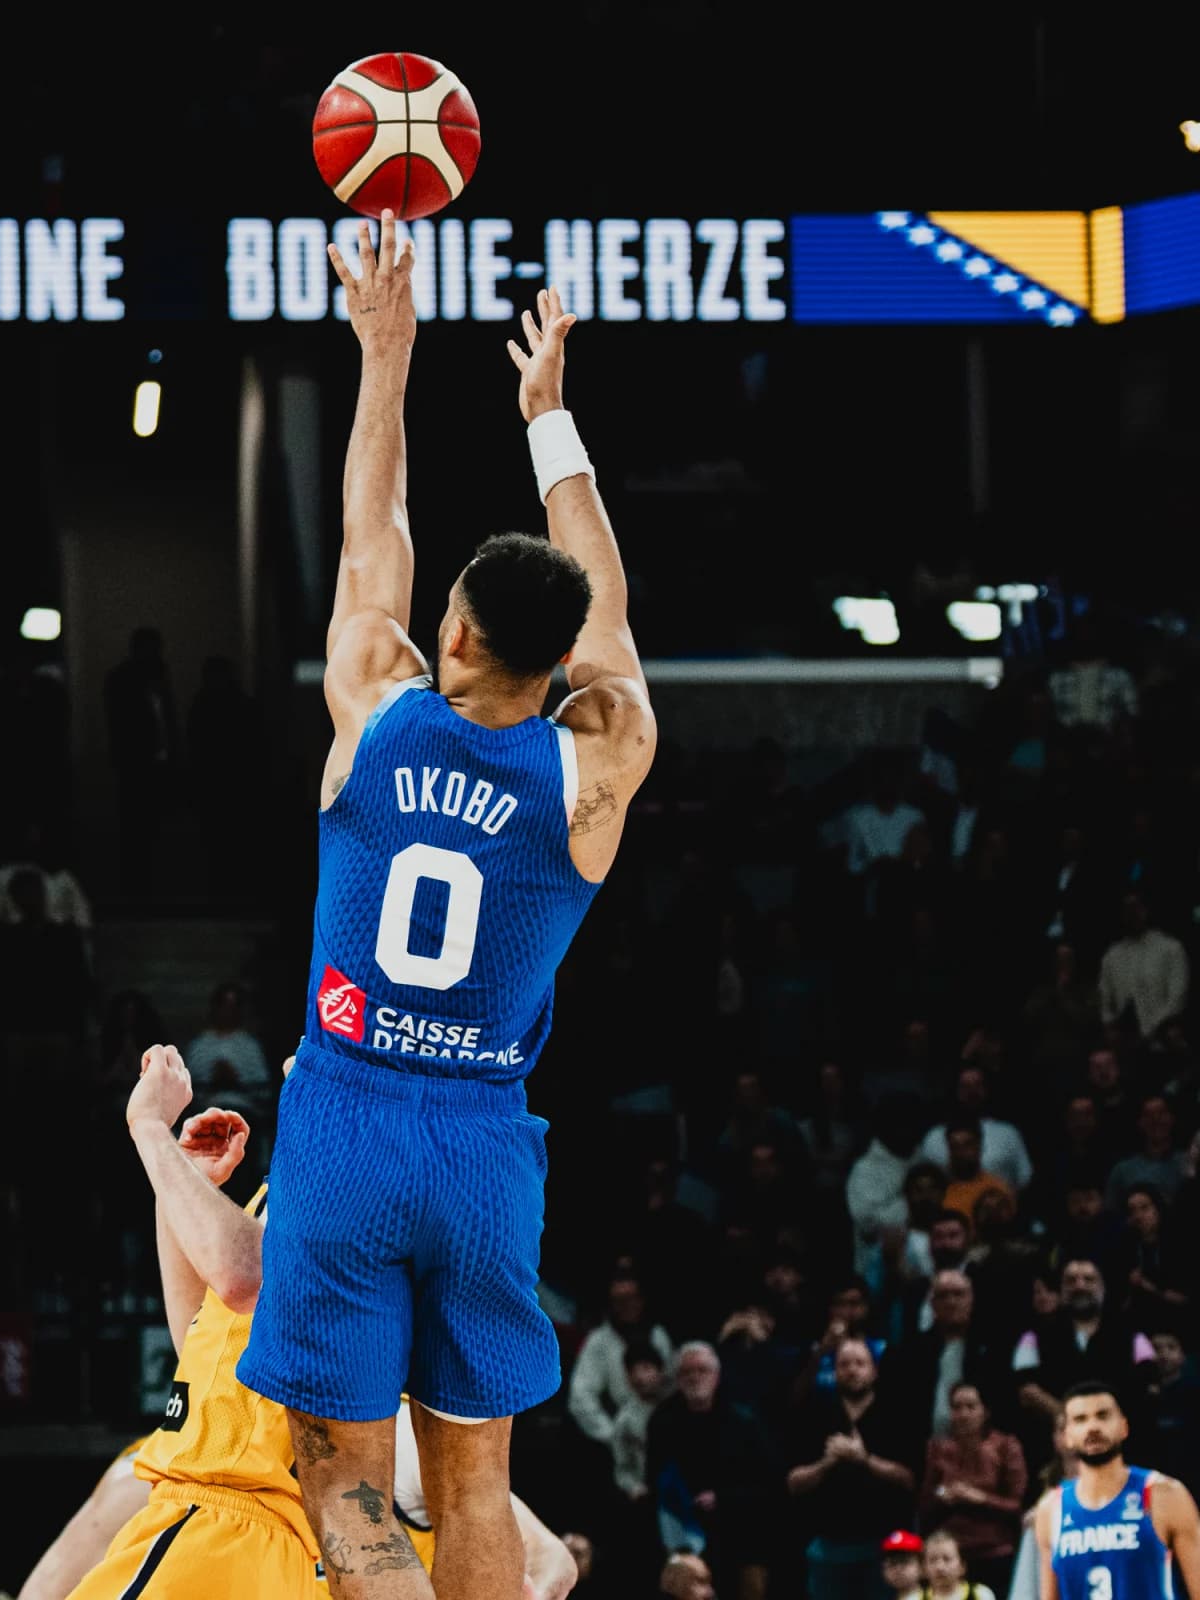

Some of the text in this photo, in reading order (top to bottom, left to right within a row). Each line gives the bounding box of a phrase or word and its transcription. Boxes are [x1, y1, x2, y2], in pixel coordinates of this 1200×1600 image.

[394, 766, 518, 835] OKOBO
[375, 843, 484, 991] 0
[376, 1007, 481, 1048] CAISSE
[1060, 1523, 1140, 1558] FRANCE
[1088, 1566, 1113, 1600] 3
